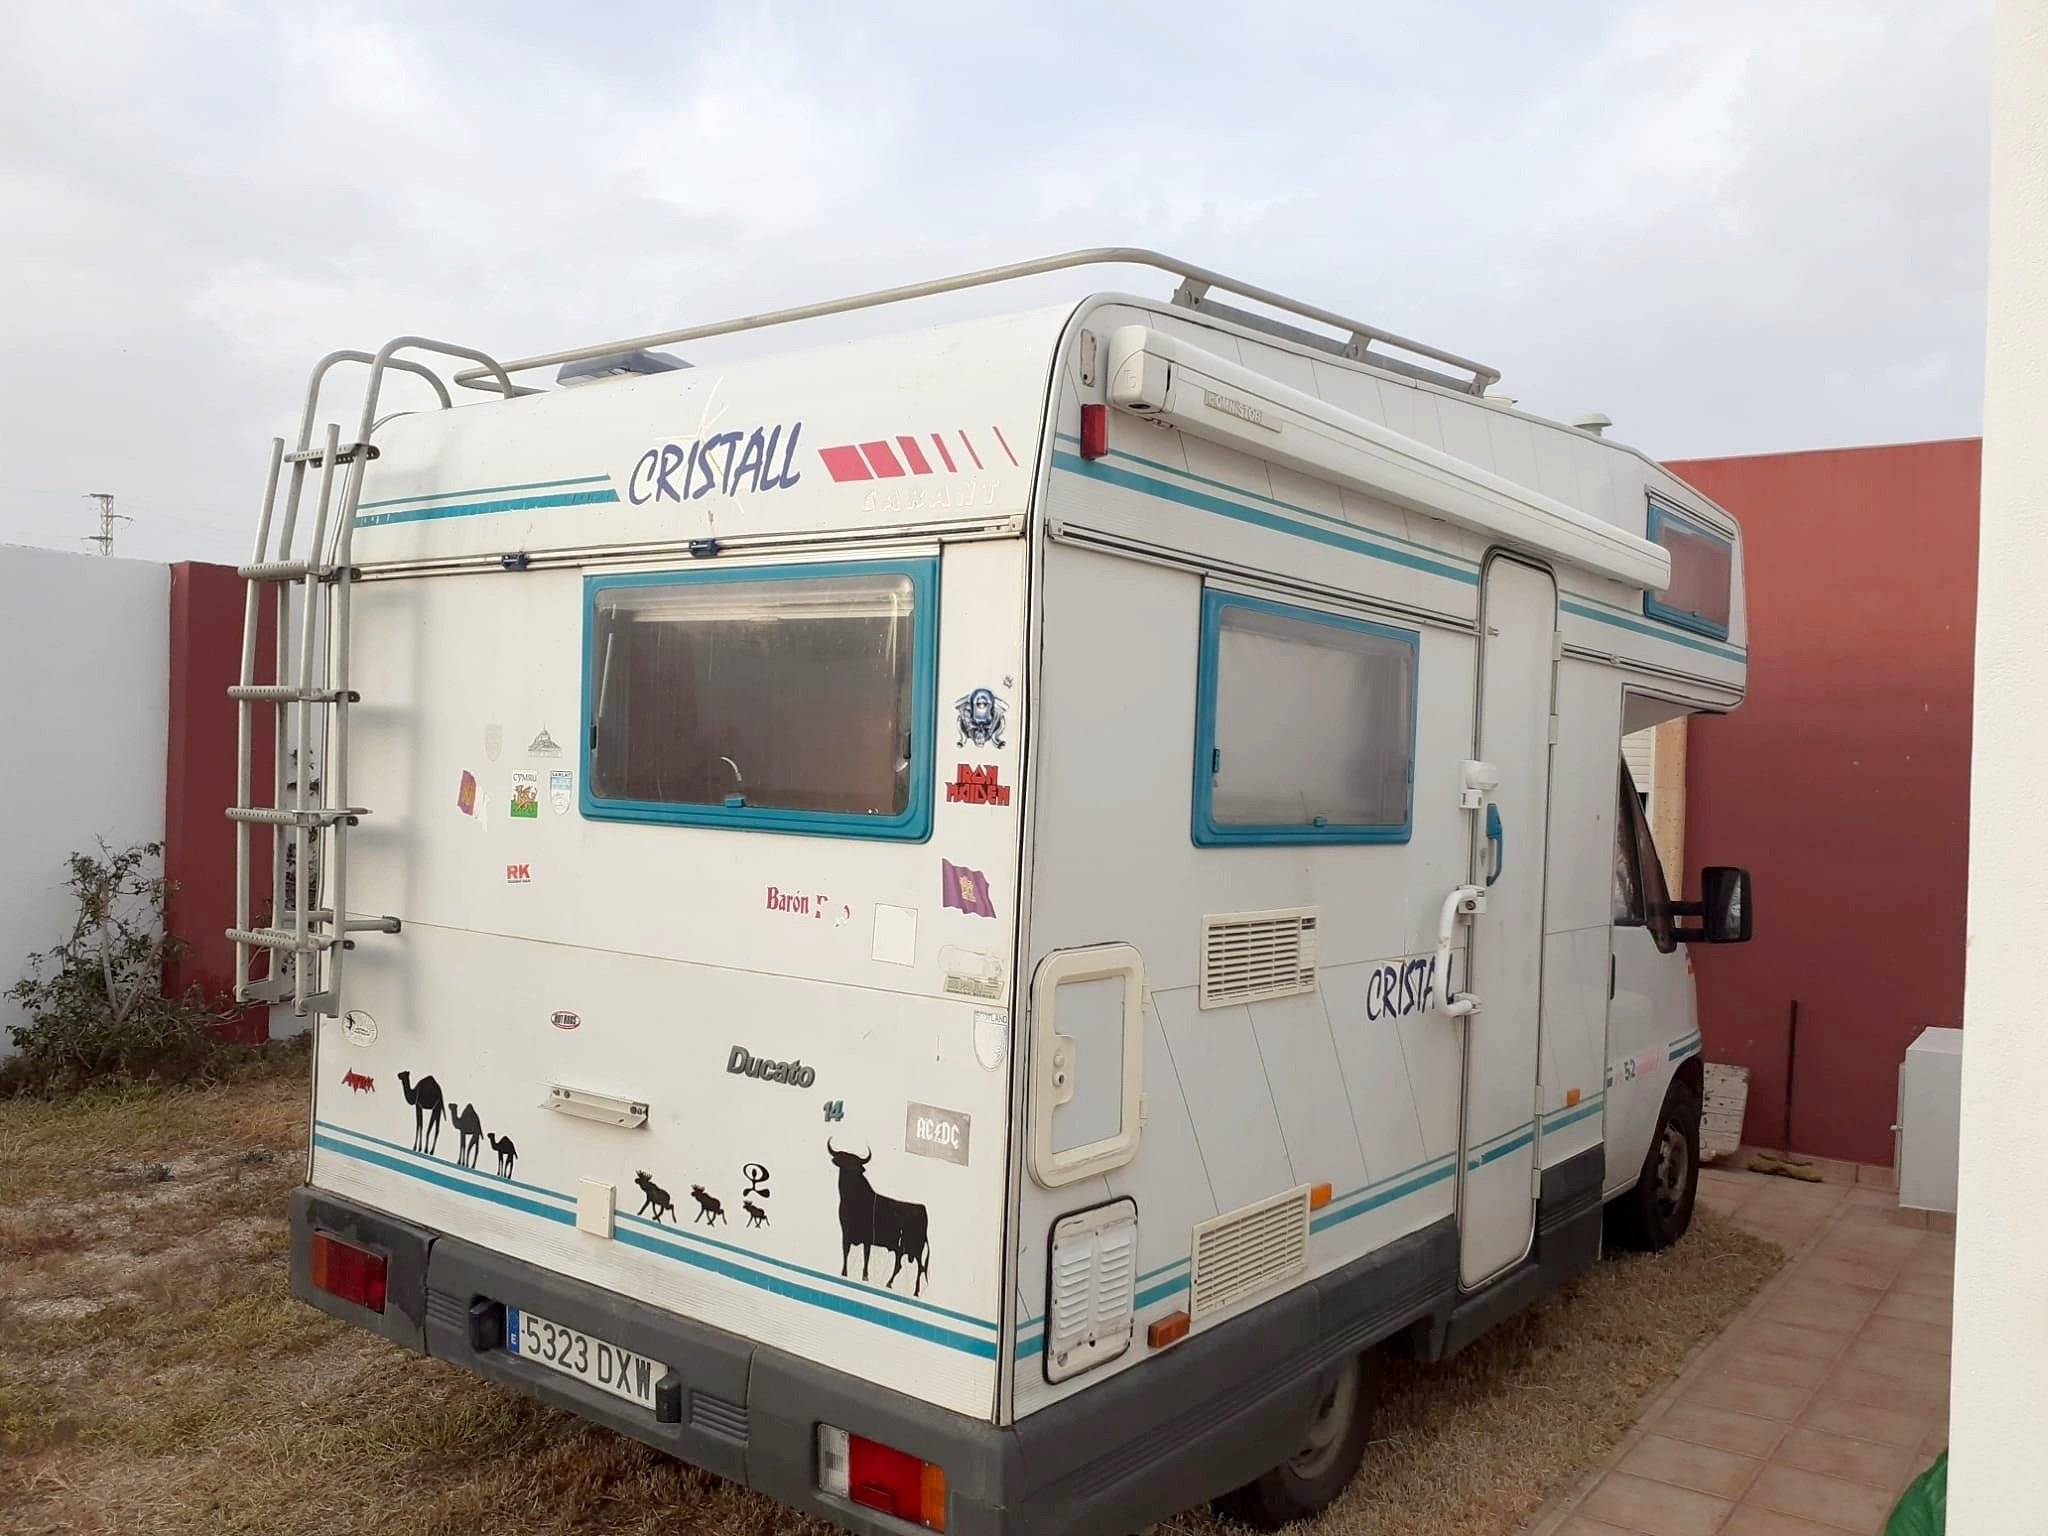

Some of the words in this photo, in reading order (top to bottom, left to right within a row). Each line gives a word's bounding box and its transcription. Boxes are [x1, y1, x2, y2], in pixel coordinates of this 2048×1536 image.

[628, 421, 802, 506] CRISTALL
[513, 773, 537, 782] CYMRU
[945, 781, 1010, 806] MAIDEN
[507, 864, 530, 880] RK
[766, 886, 809, 914] Barón
[1366, 952, 1454, 1021] CRISTAL
[726, 1044, 816, 1088] Ducato
[823, 1099, 844, 1121] 14
[526, 1314, 589, 1373] 5323
[597, 1342, 652, 1400] DXW
